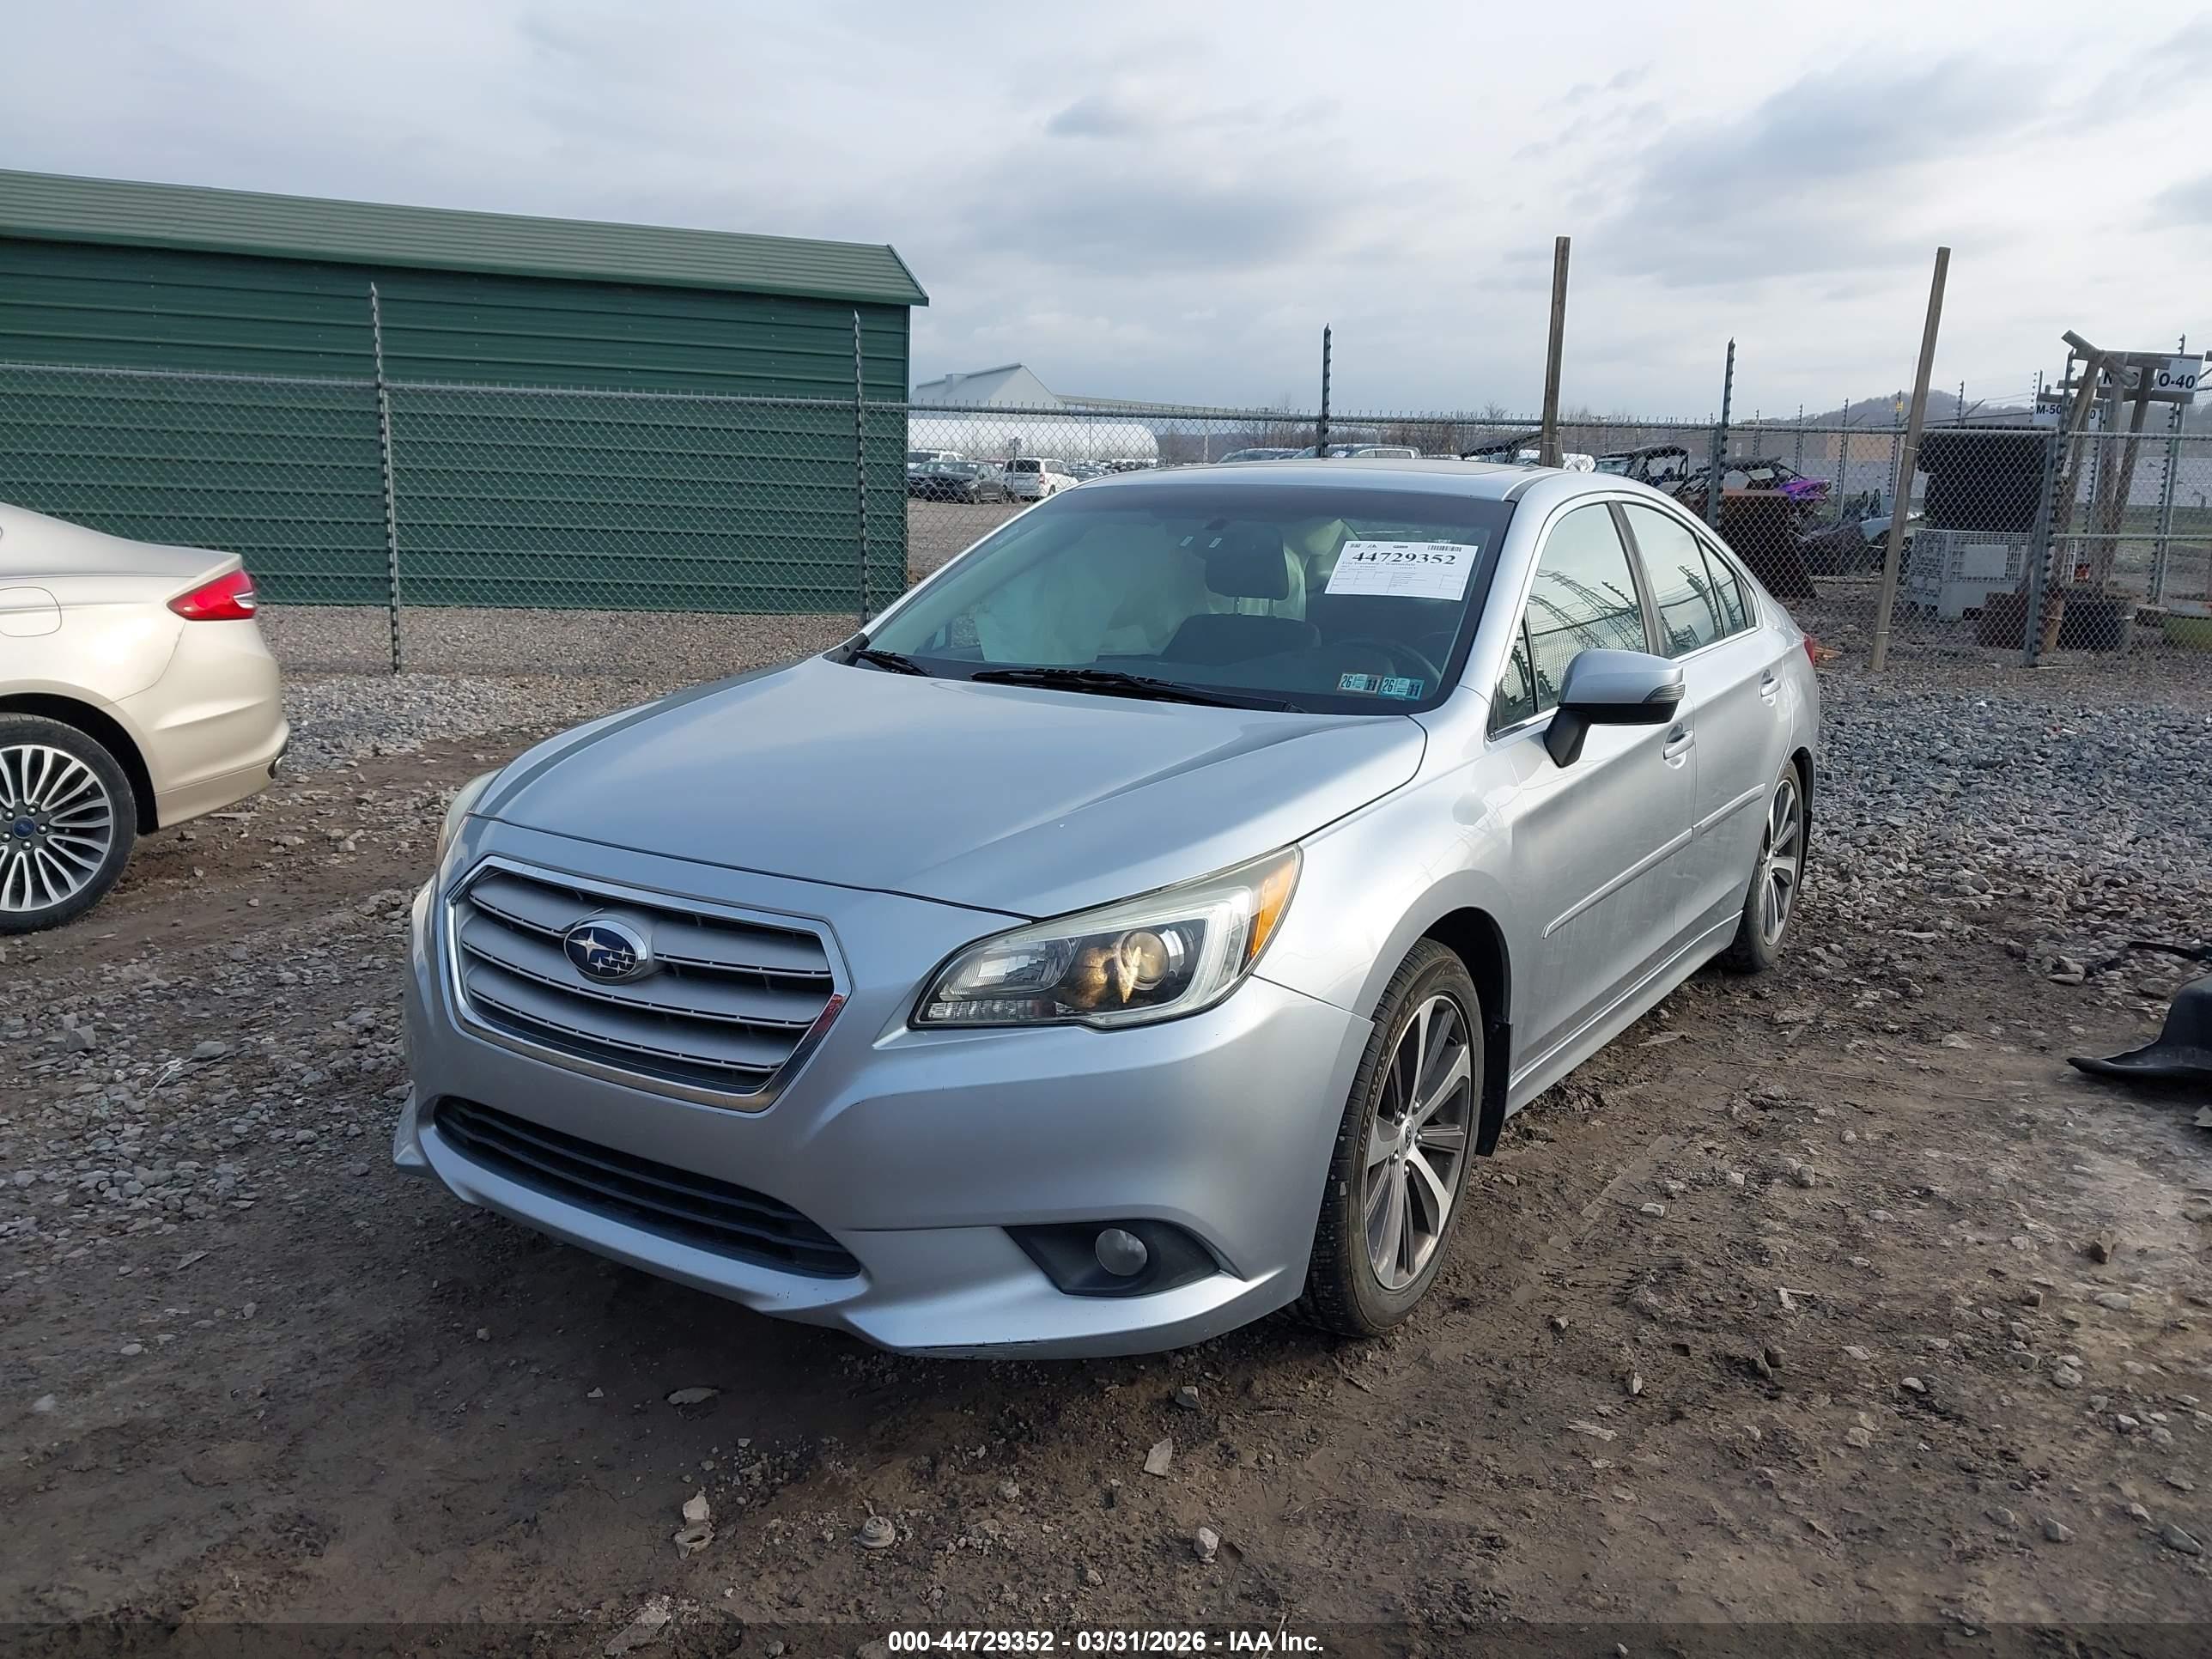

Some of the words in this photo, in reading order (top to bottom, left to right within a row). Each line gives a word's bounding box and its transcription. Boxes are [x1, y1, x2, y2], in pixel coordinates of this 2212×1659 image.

[2158, 373, 2196, 389] O-40
[2036, 404, 2062, 415] M-50
[1352, 552, 1455, 565] 44729352
[1340, 675, 1353, 688] 26
[1365, 679, 1377, 690] 11
[1382, 678, 1395, 692] 26
[1409, 684, 1419, 696] 11
[1359, 1054, 1388, 1154] ULTRAMAX
[1388, 1016, 1402, 1044] UHP
[1403, 993, 1415, 1012] AS
